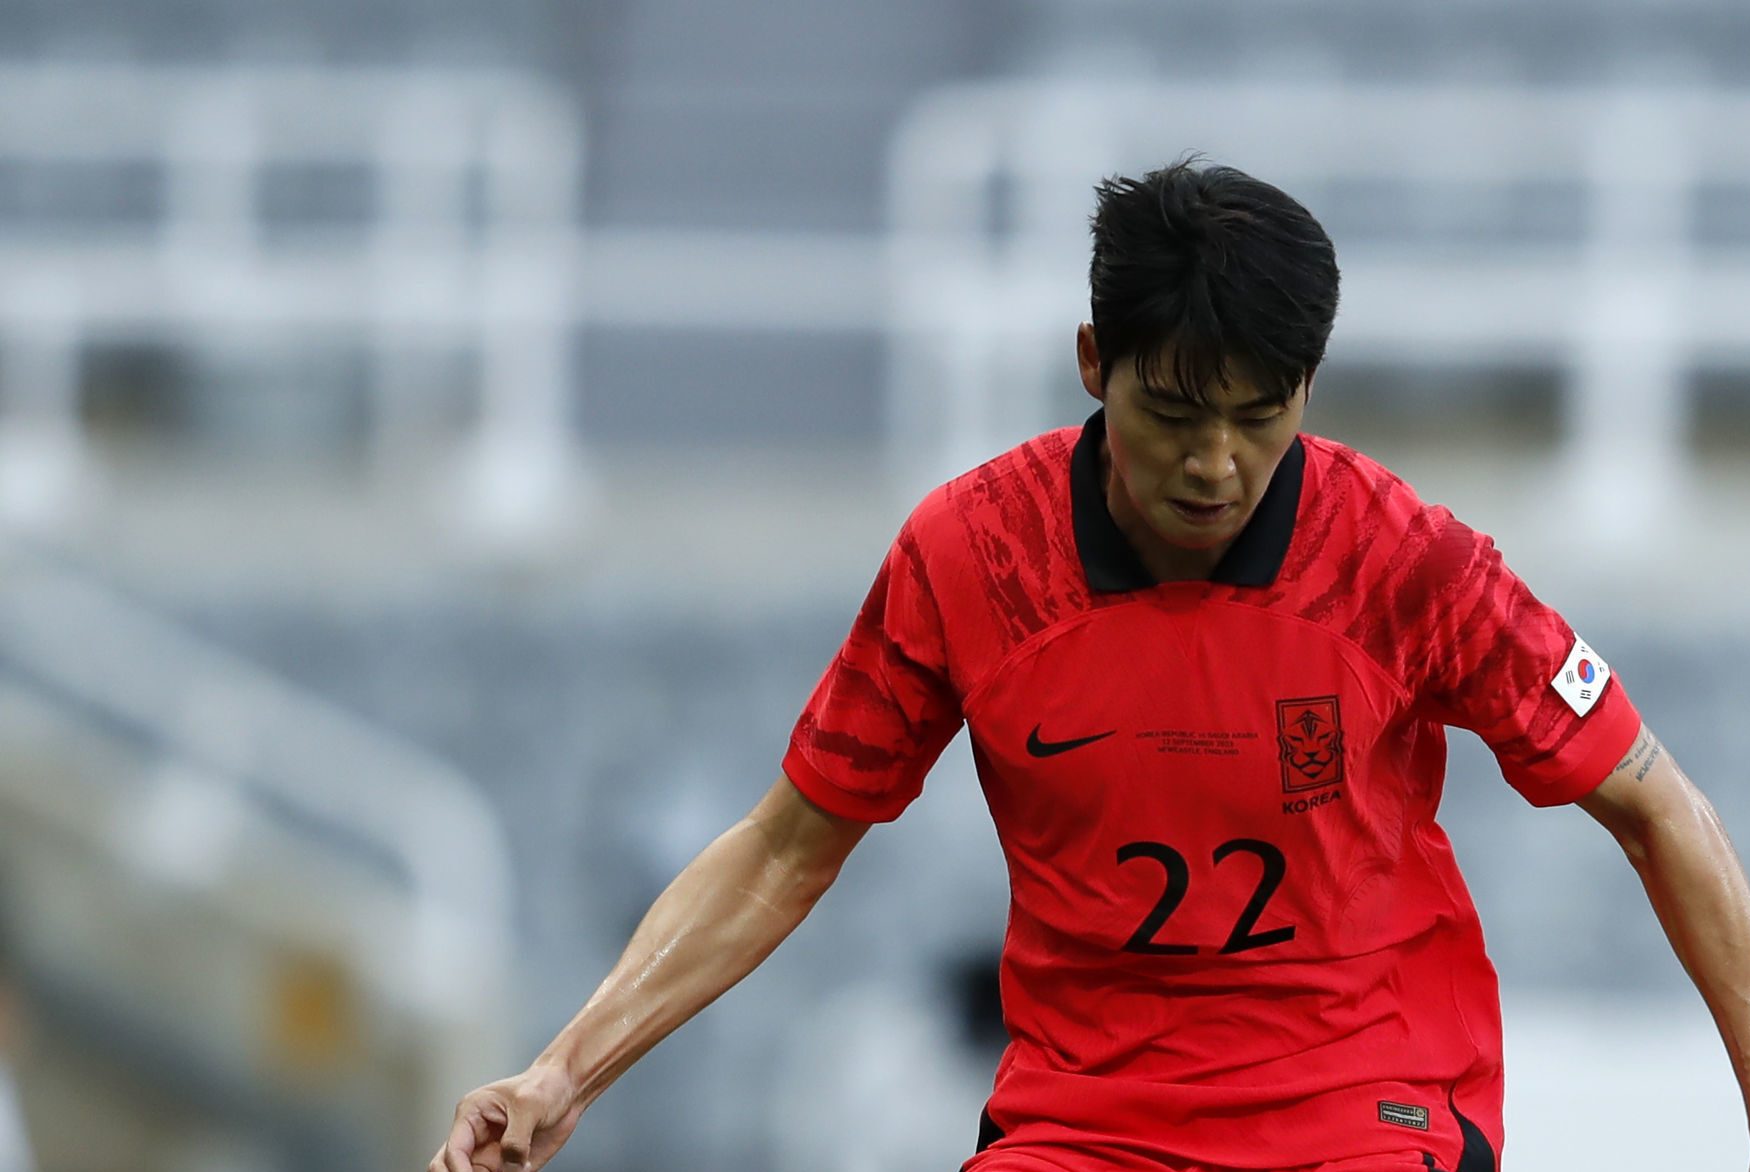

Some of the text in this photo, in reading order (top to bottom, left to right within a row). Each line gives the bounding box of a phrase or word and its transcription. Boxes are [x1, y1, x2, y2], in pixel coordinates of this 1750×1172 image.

[1161, 730, 1195, 738] REPUBLIC
[1172, 739, 1215, 747] SEPTEMBER
[1204, 748, 1240, 756] ENGLAND
[1282, 790, 1342, 816] KOREA
[1116, 838, 1297, 955] 22
